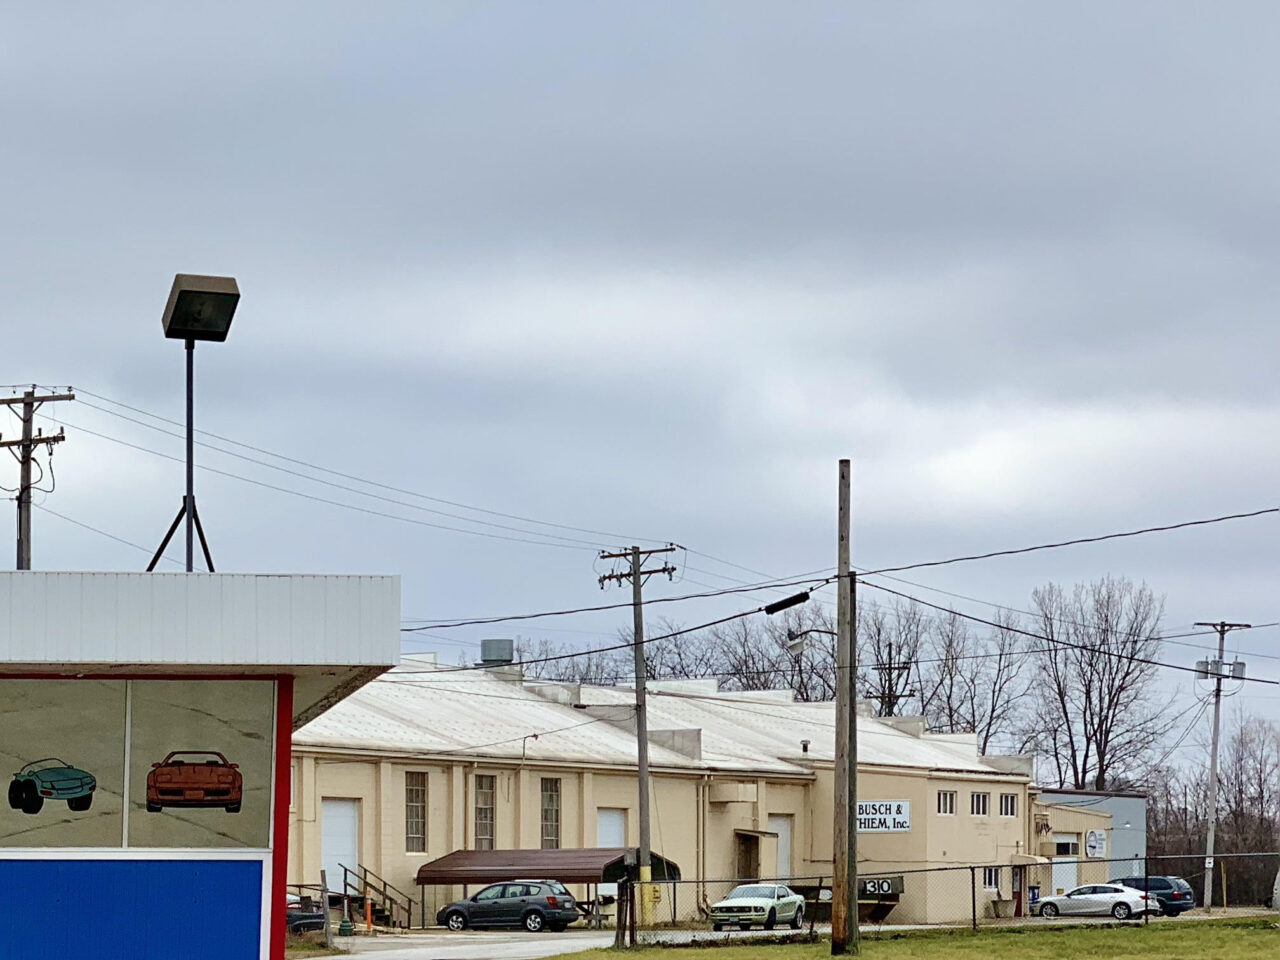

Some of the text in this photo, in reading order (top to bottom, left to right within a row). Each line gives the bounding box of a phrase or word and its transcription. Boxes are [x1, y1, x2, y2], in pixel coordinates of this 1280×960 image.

[858, 804, 904, 815] BUSCH &
[893, 818, 910, 829] Inc.
